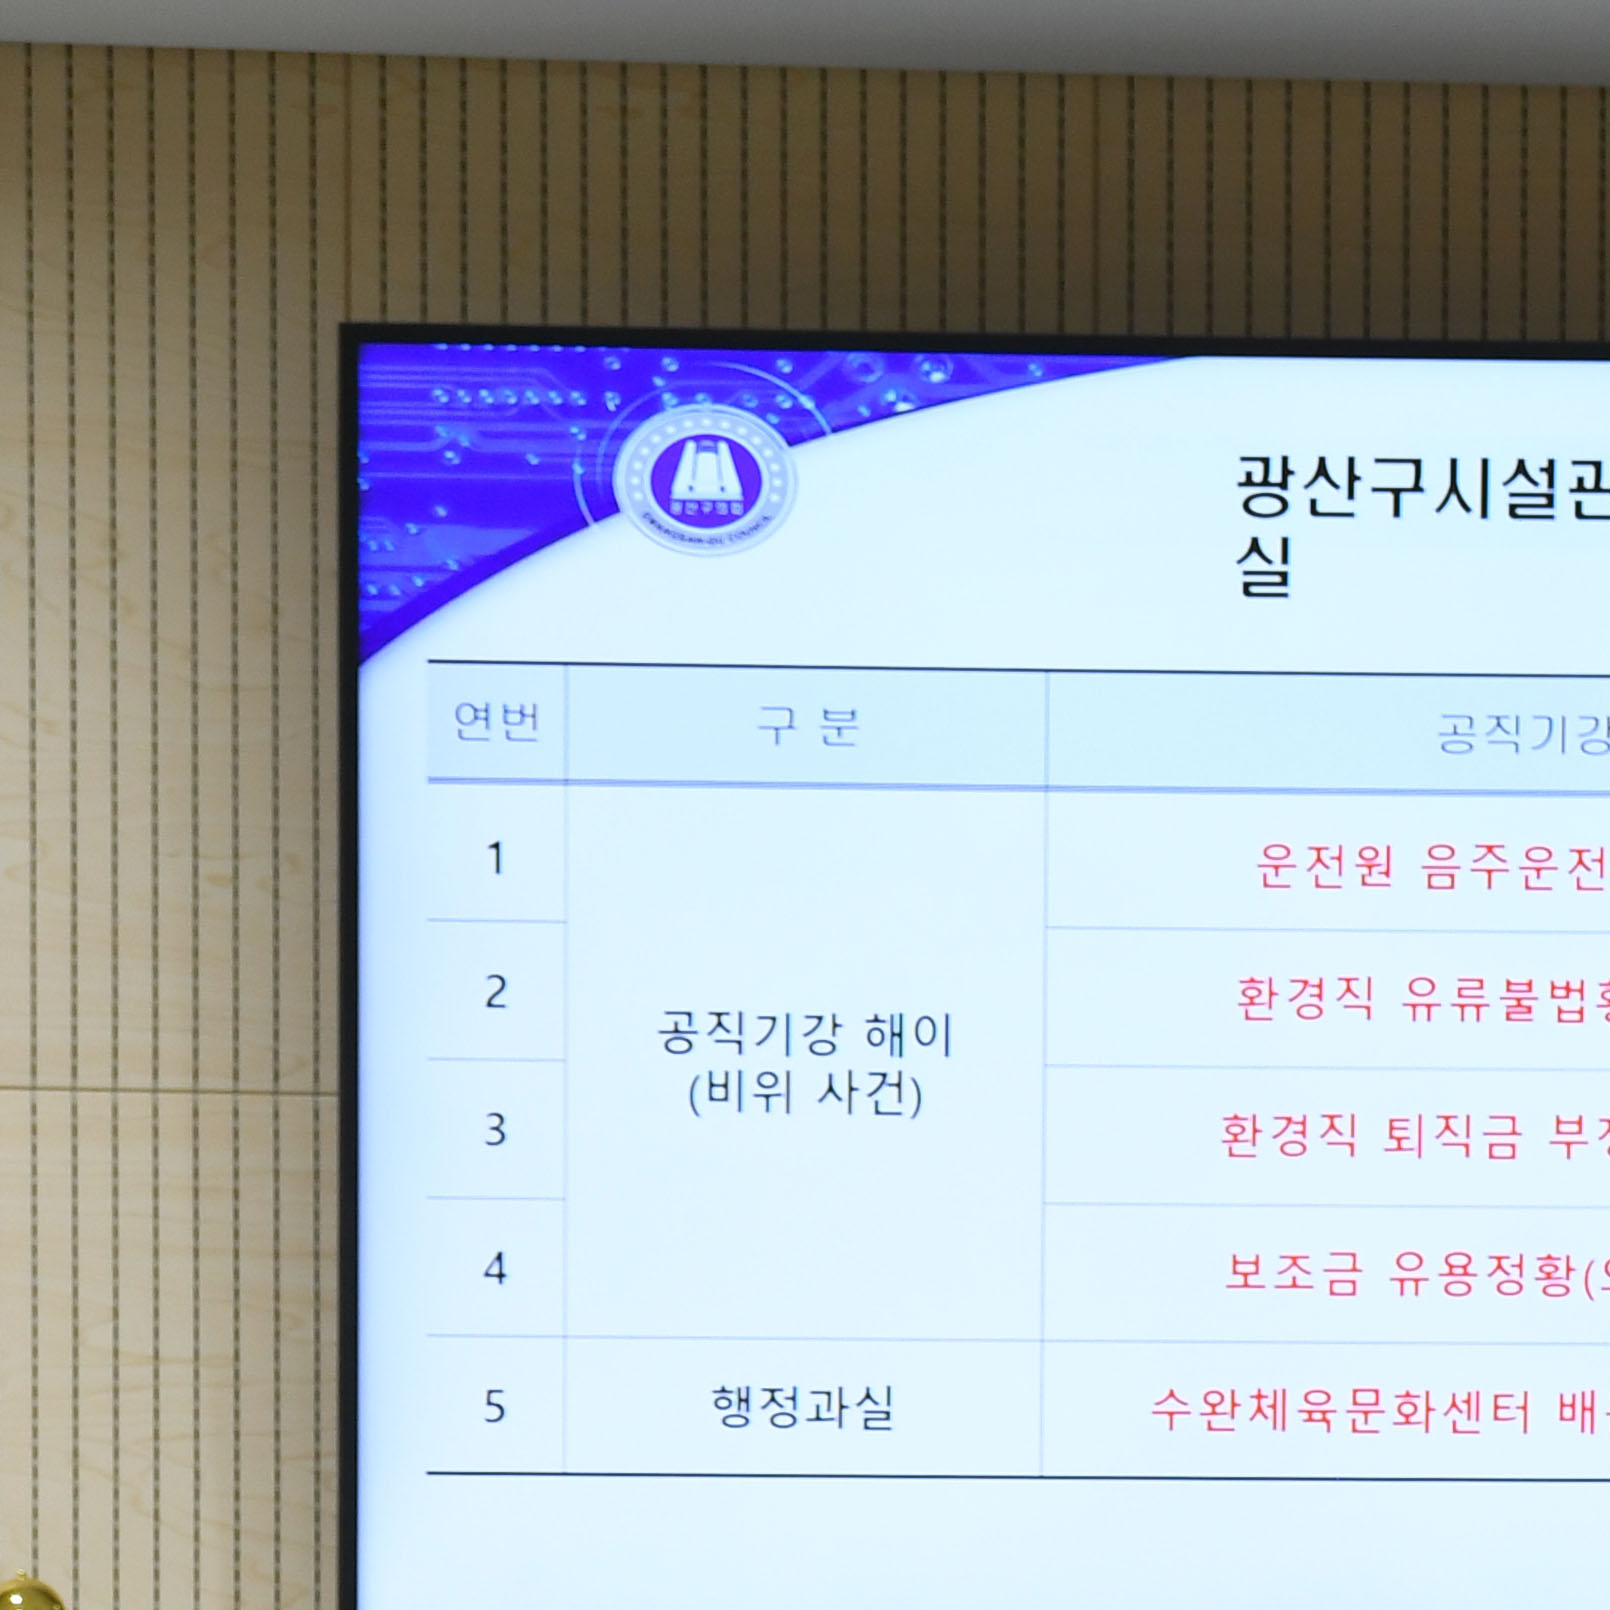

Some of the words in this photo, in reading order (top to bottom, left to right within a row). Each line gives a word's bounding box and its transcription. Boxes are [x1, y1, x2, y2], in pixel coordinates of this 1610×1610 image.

[1236, 536, 1290, 599] 실
[454, 702, 537, 742] 연번
[758, 706, 796, 746] 구
[820, 708, 858, 747] 분
[488, 840, 502, 875] 1
[1257, 843, 1392, 889] 운전원
[1421, 843, 1605, 892] 음주운전
[485, 974, 507, 1009] 2
[1237, 976, 1372, 1022] 환경직
[658, 1010, 843, 1058] 공직기강
[865, 1012, 950, 1059] 해이
[689, 1069, 791, 1117] (비위
[817, 1069, 922, 1119] 사건)
[485, 1112, 507, 1147] 3
[1221, 1113, 1356, 1159] 환경직
[1383, 1113, 1523, 1161] 퇴직금
[483, 1251, 508, 1285] 4
[1225, 1251, 1363, 1297] 보조금
[484, 1389, 506, 1423] 5
[711, 1385, 893, 1432] 행정과실
[1151, 1387, 1529, 1435] 수완체육문화센터
